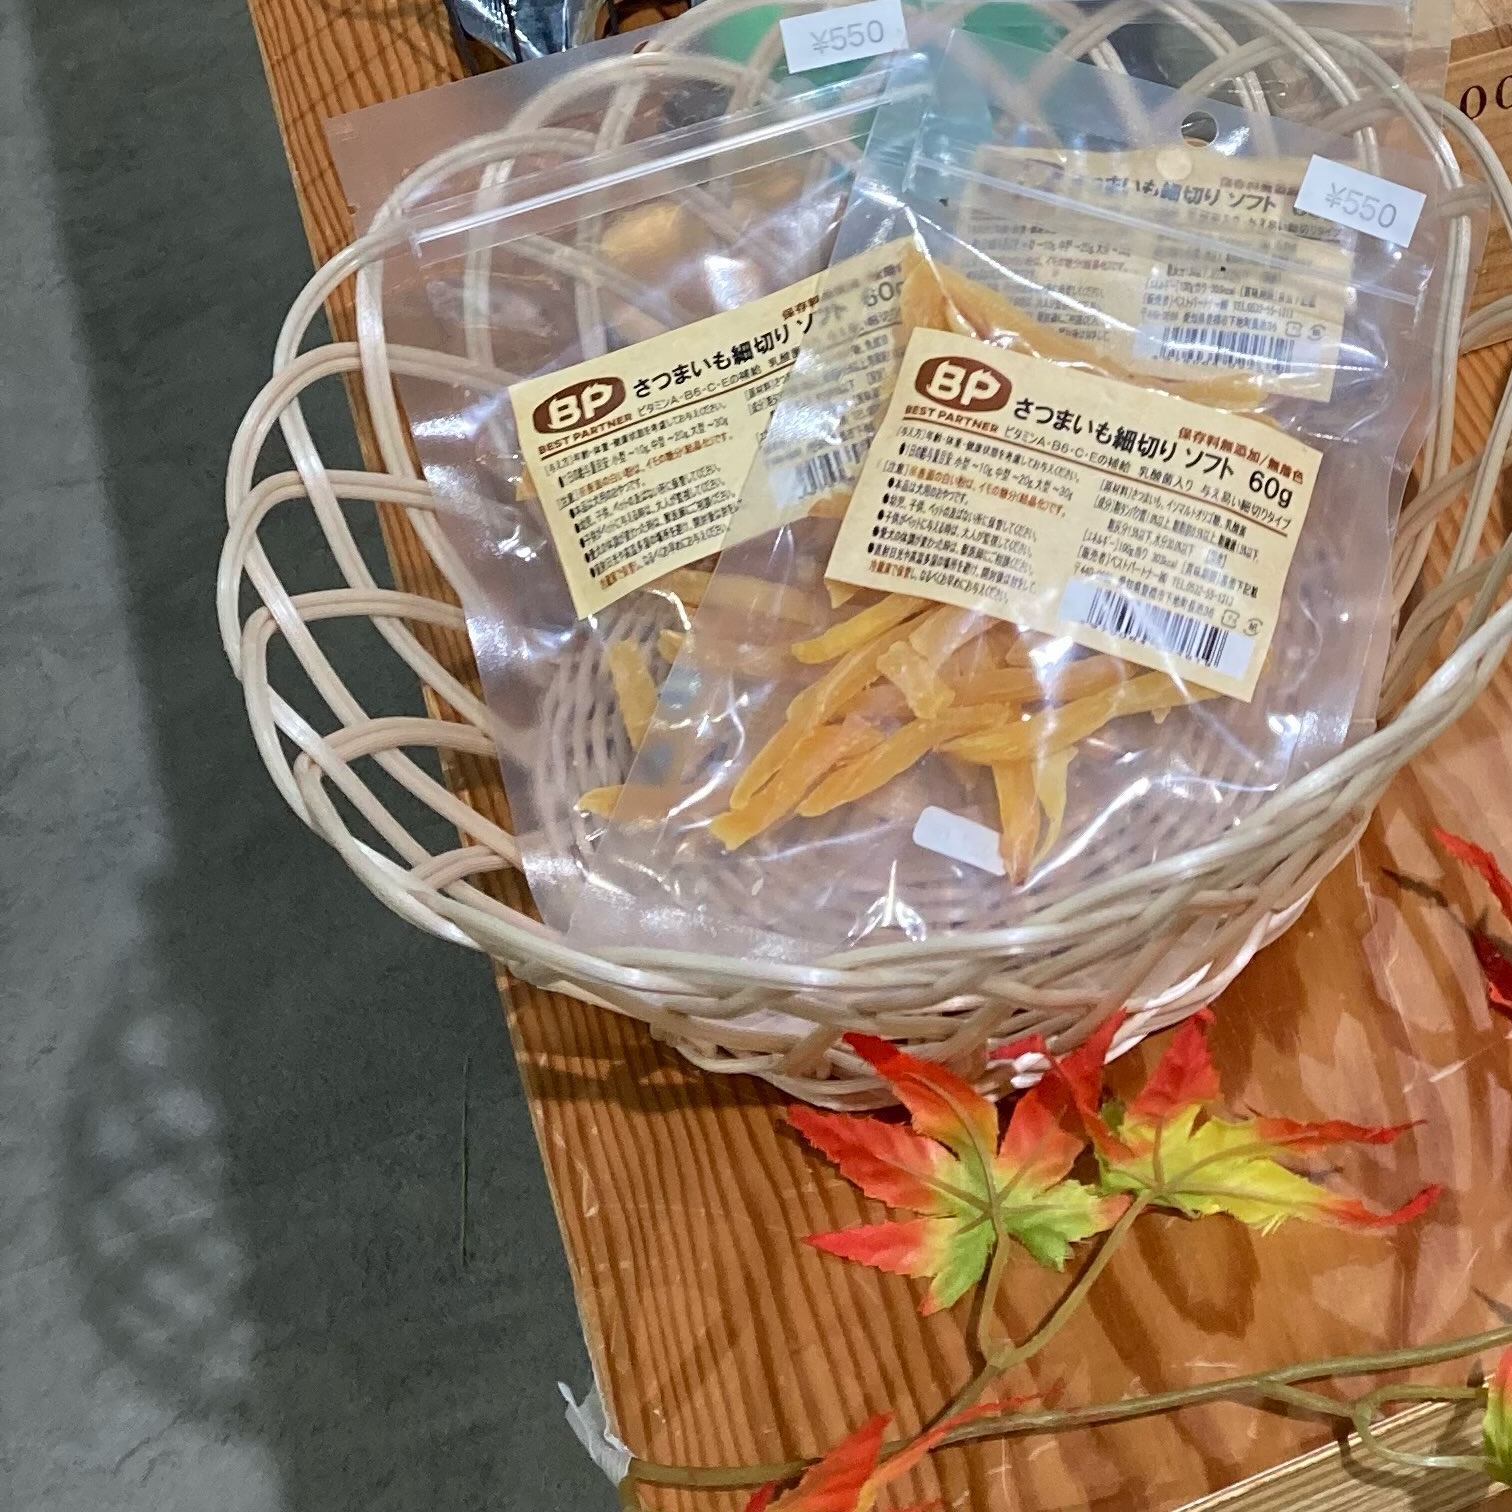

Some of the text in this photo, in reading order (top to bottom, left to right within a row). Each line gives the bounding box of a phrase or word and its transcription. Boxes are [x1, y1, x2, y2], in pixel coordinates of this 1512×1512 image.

[810, 18, 886, 55] ¥550
[1228, 191, 1276, 213] ソフト
[1325, 182, 1398, 230] ¥550
[633, 323, 790, 400] さつまいも細切り
[926, 360, 1001, 406] BP
[547, 382, 614, 429] BP
[904, 404, 1000, 434] BEST PARTNER
[537, 413, 633, 455] BEST PARTNER
[1013, 397, 1293, 509] さつまいも細切り ソフト 60g
[1178, 426, 1304, 485] 保存料無添加/無着色
[1139, 466, 1194, 491] 乳酸菌入り
[1200, 484, 1292, 530] 与え易い細切りタイプ
